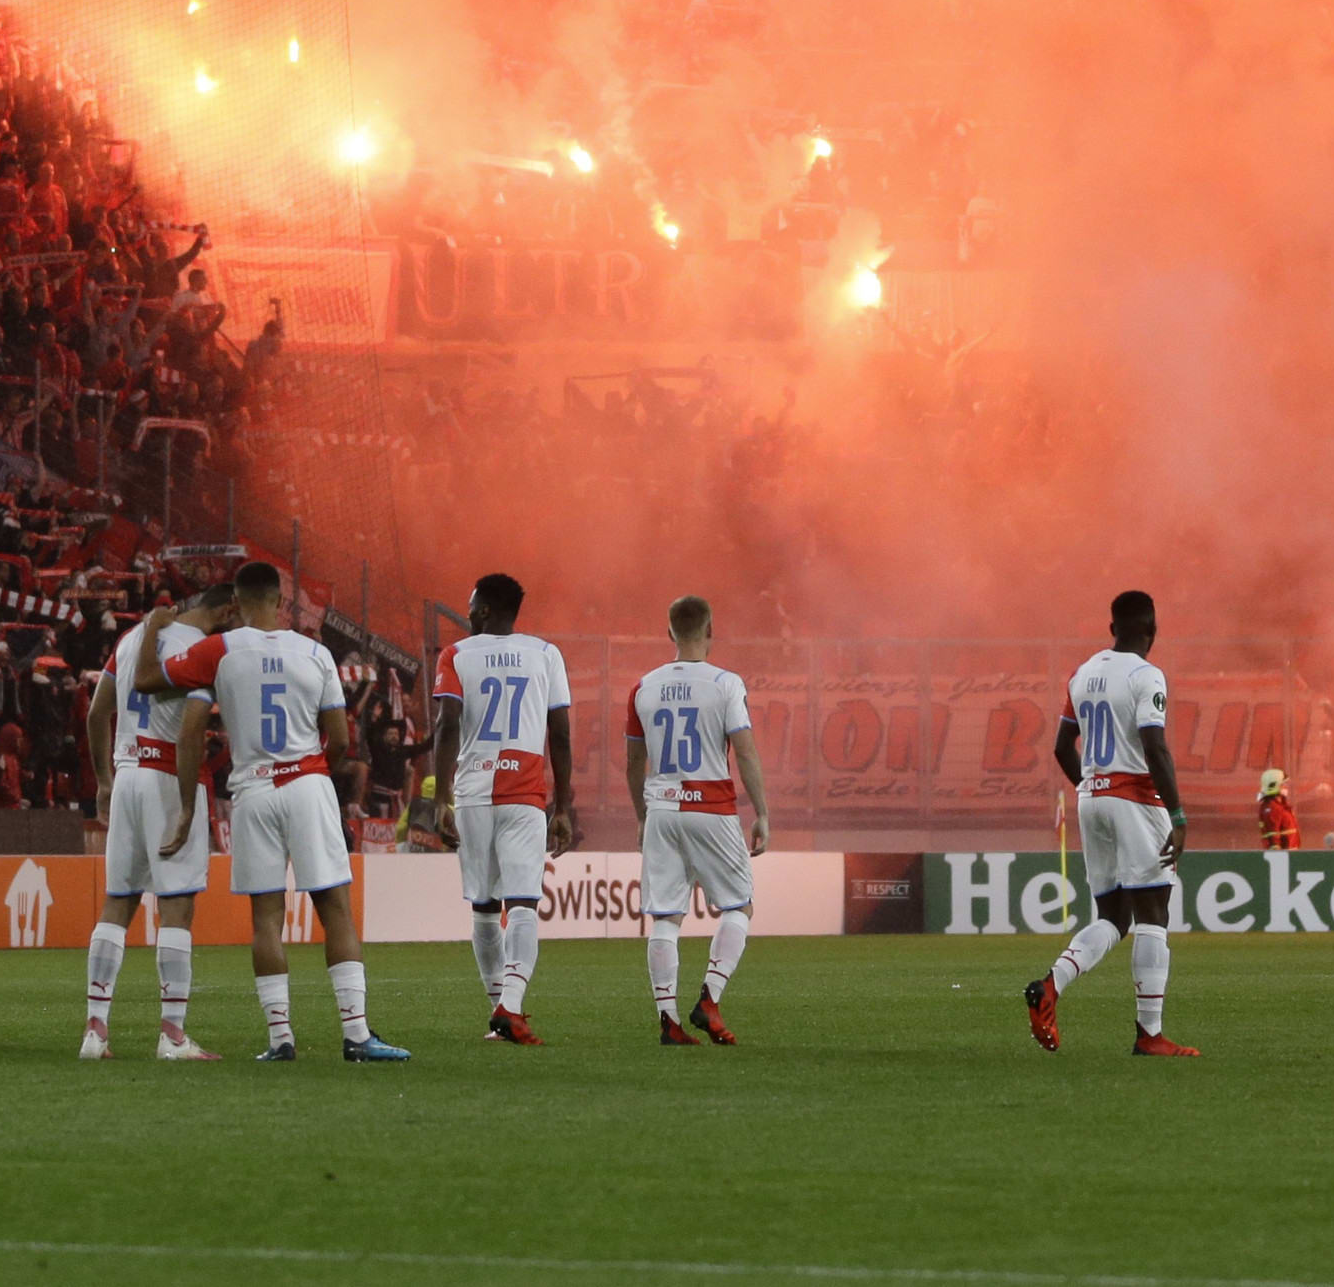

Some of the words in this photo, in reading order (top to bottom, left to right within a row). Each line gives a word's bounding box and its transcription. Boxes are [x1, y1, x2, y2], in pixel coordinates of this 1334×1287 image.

[262, 657, 284, 675] BAH
[260, 683, 287, 754] 5
[478, 675, 530, 742] 27
[653, 706, 702, 774] 23
[1078, 699, 1115, 767] 20
[866, 884, 911, 895] RESPECT
